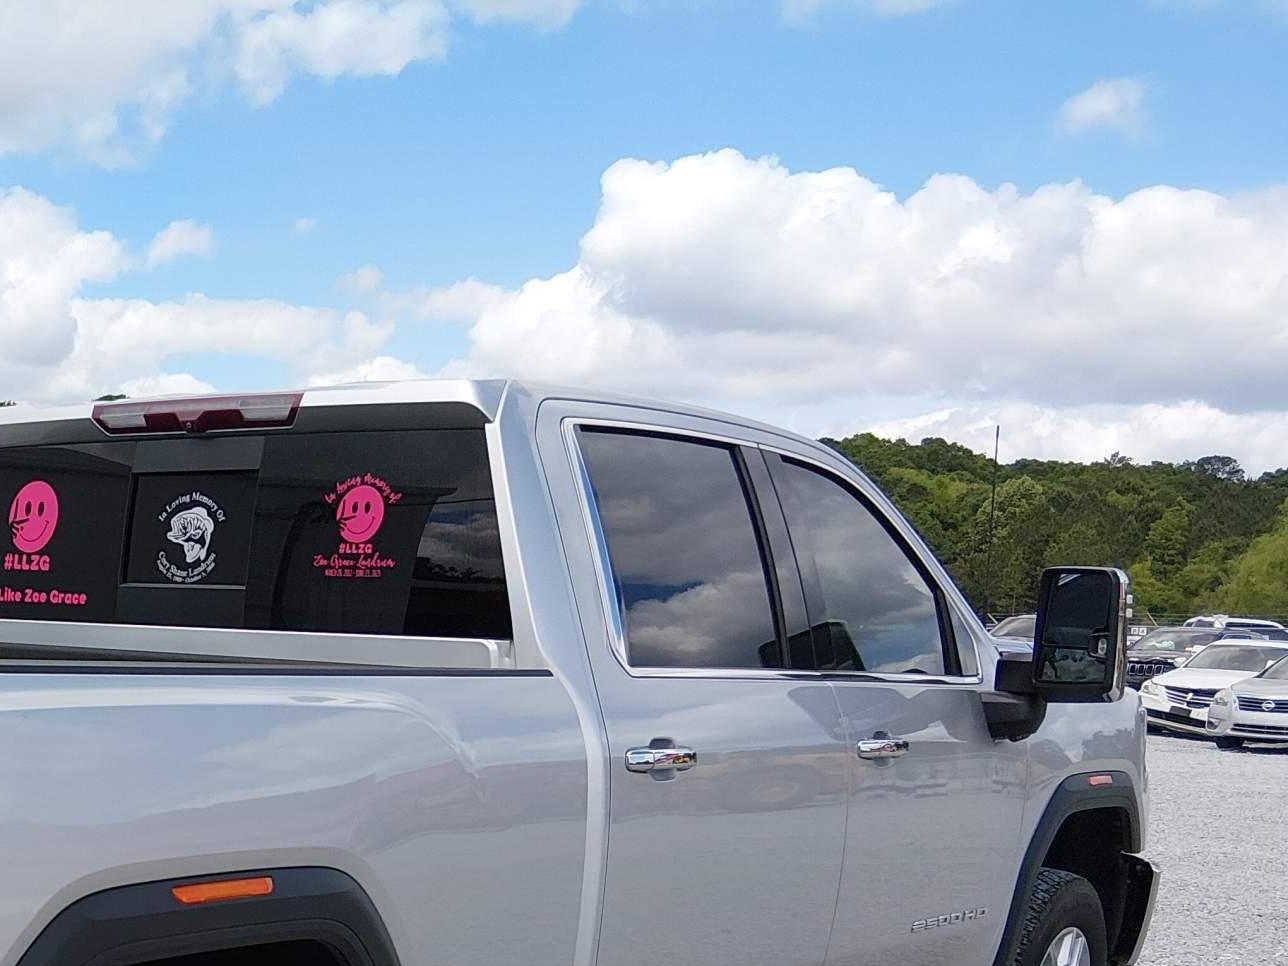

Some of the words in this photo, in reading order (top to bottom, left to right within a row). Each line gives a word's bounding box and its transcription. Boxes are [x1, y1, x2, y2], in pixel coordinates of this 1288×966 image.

[158, 510, 168, 522] In
[165, 494, 191, 513] Loving
[191, 491, 219, 512] Memory
[338, 543, 373, 554] #LLZG
[4, 553, 50, 571] #LLZG
[24, 588, 47, 604] Zoe
[49, 590, 87, 605] Grace
